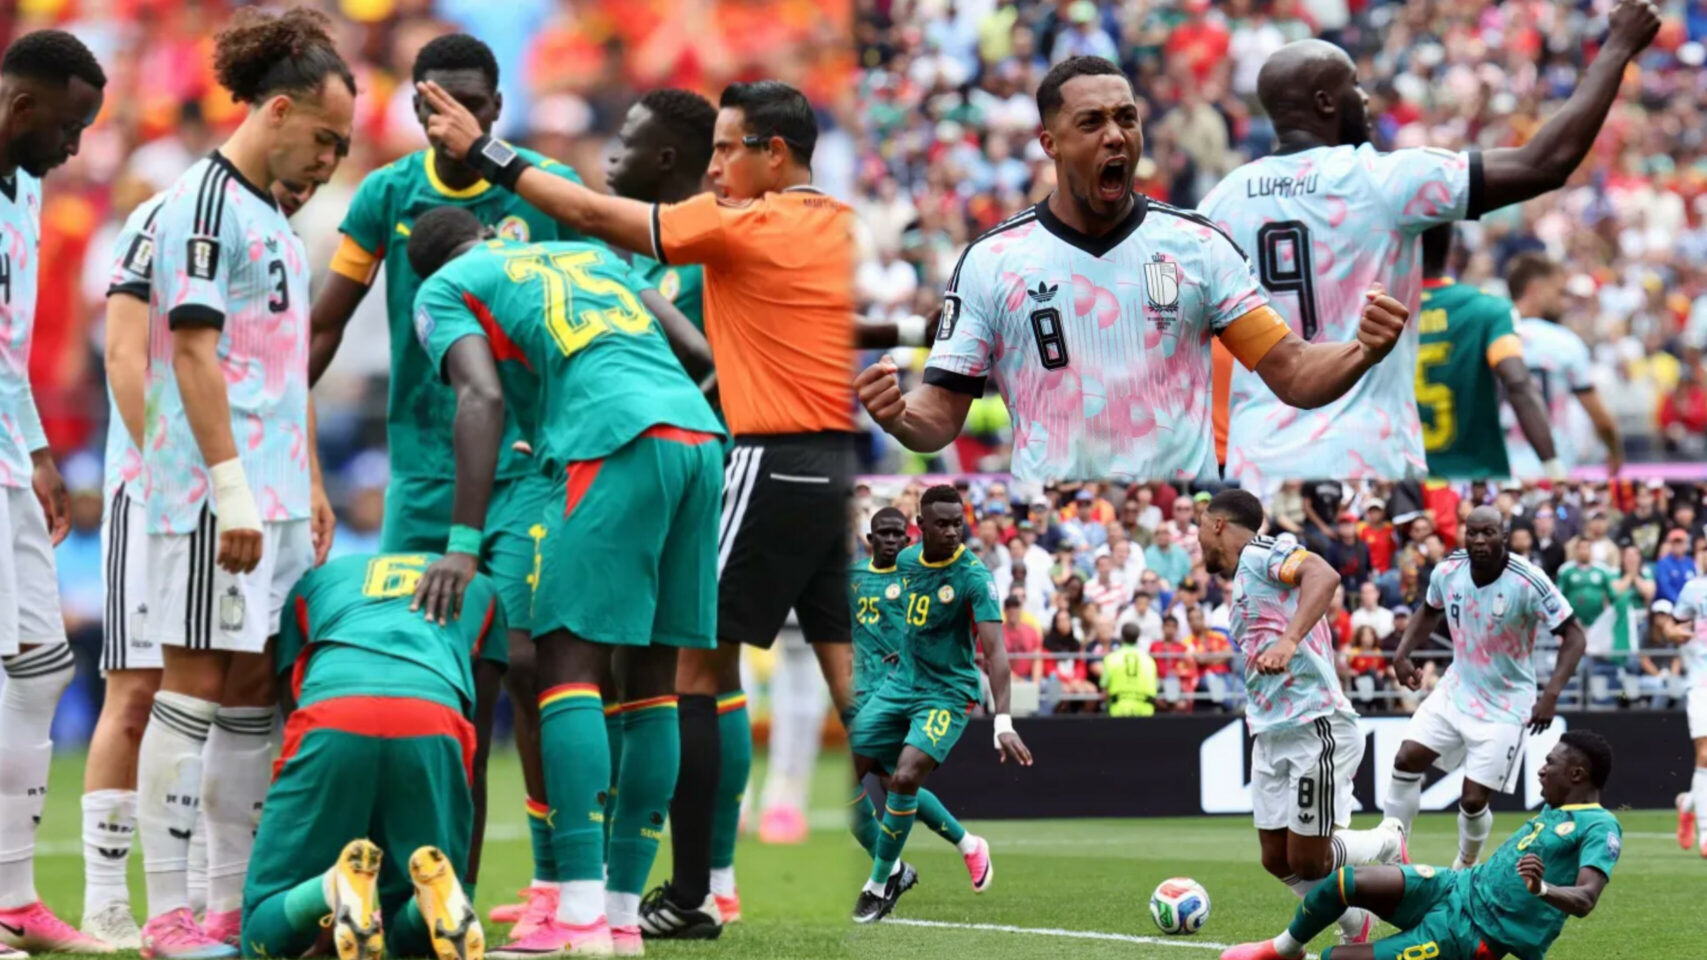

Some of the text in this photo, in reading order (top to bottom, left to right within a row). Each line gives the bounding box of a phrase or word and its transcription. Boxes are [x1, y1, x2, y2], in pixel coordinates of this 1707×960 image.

[268, 259, 290, 313] 3
[1256, 219, 1319, 342] 9
[504, 250, 655, 357] 25
[1030, 306, 1069, 373] 8
[362, 555, 429, 598] 6
[856, 596, 880, 624] 25
[906, 593, 930, 626] 19
[1450, 603, 1460, 629] 9
[922, 709, 951, 737] 19
[1298, 777, 1314, 808] 8
[1403, 940, 1439, 960] 8
